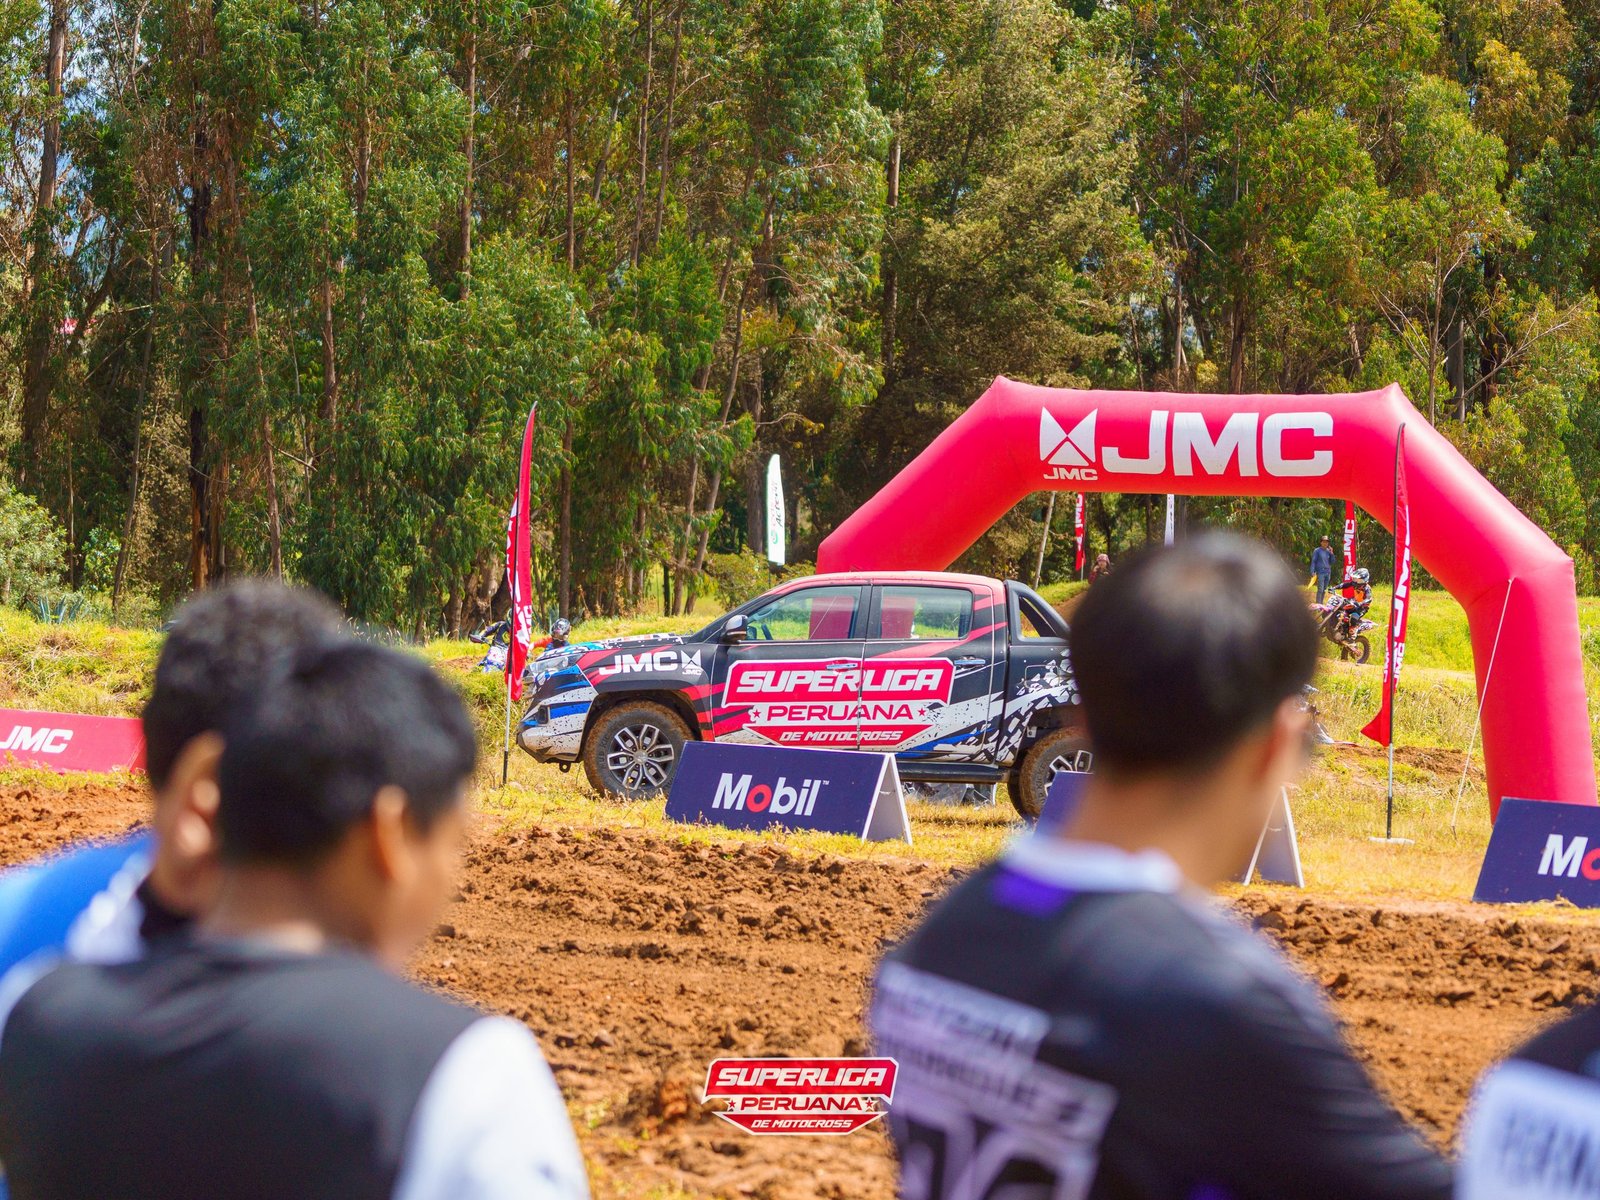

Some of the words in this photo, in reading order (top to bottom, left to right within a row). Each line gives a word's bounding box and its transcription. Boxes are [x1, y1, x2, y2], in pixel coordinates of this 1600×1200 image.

[1102, 410, 1333, 477] JMC
[1043, 467, 1098, 481] JMC
[1343, 519, 1355, 565] JMC
[598, 651, 678, 675] JMC
[682, 668, 702, 676] JMC
[736, 668, 944, 693] SUPERLIGA
[767, 703, 914, 721] PERUANA
[0, 725, 74, 754] JMC
[779, 731, 804, 741] DE
[804, 730, 903, 741] MOTOCROSS
[712, 773, 821, 816] Mobil
